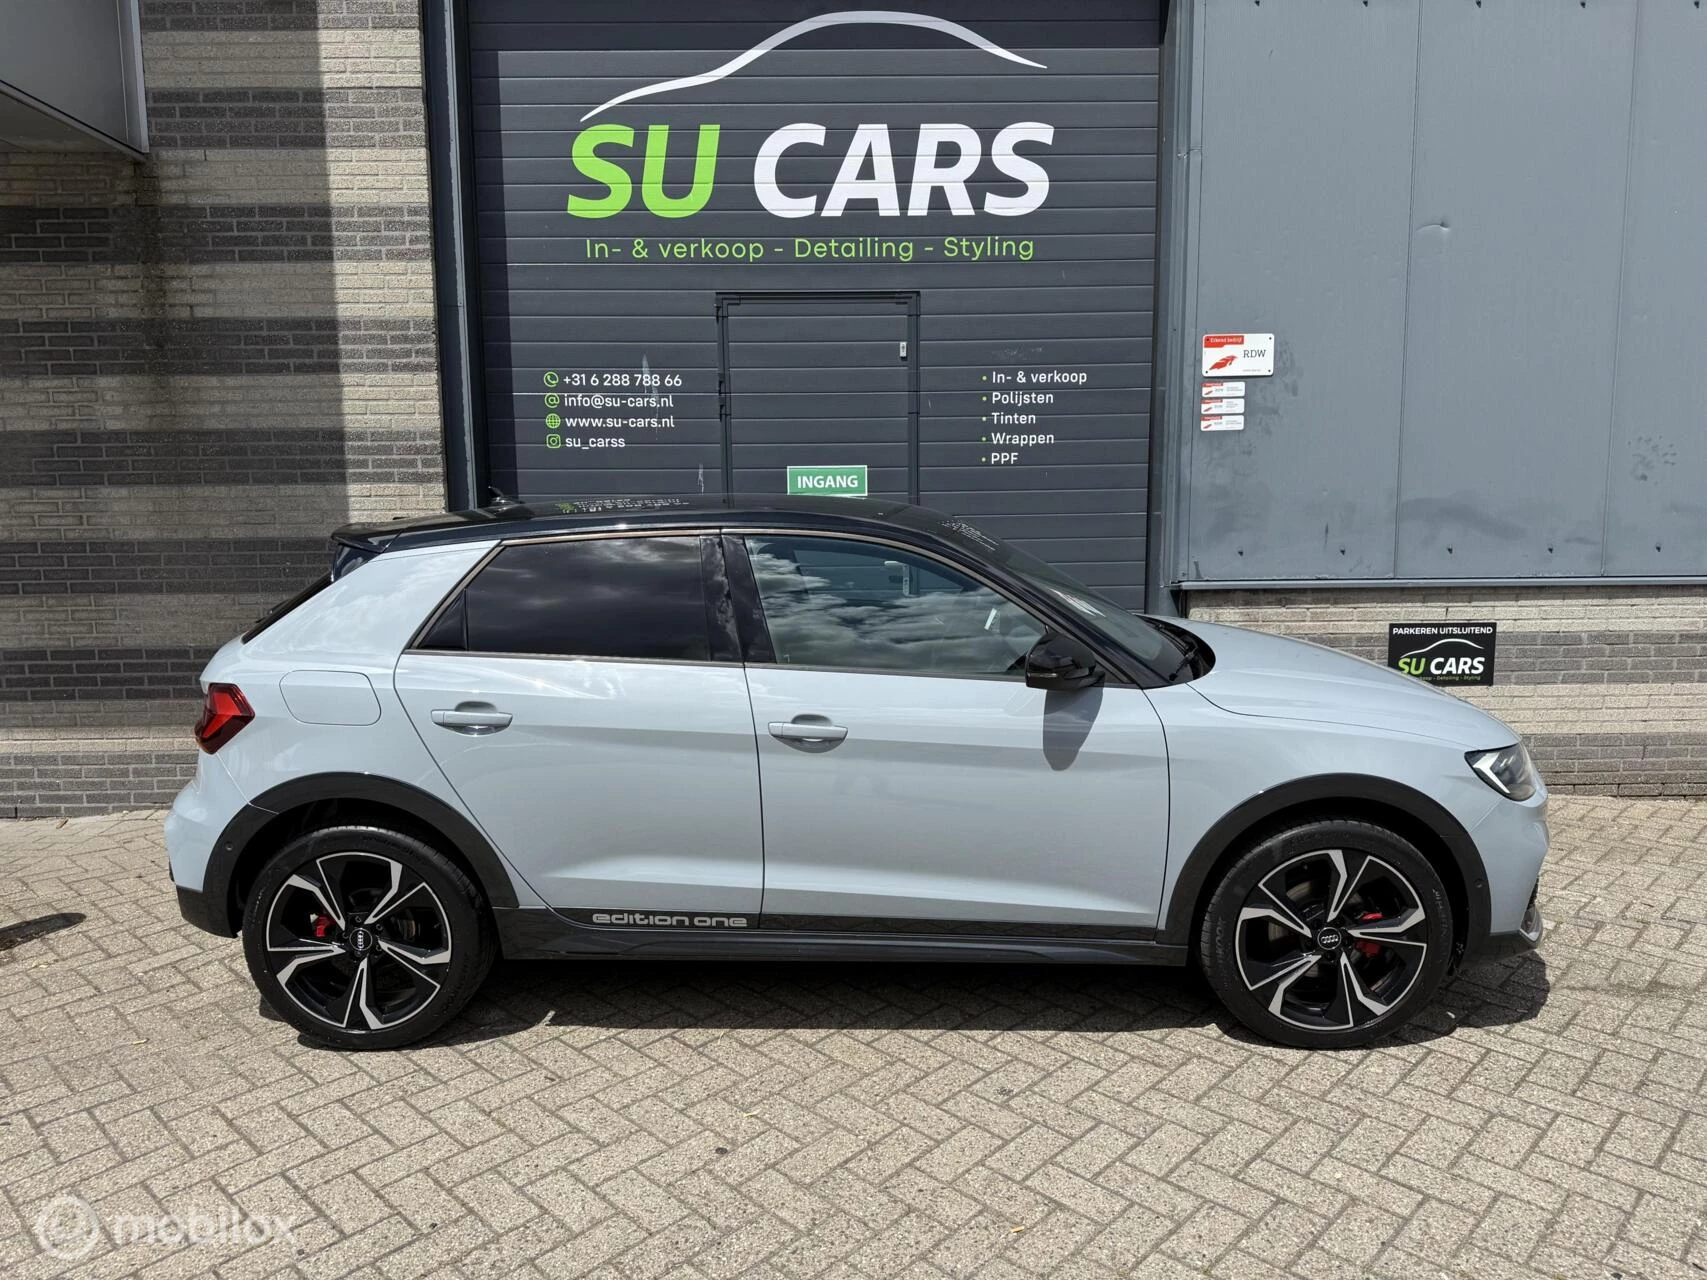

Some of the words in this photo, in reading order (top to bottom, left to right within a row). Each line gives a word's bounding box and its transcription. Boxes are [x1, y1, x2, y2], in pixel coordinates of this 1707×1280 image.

[567, 124, 720, 218] SU
[753, 121, 1055, 218] CARS
[585, 239, 622, 259] In-
[631, 239, 649, 259] &
[658, 238, 764, 264] verkoop
[794, 237, 914, 261] Detailing
[943, 236, 1035, 261] Styling
[1243, 349, 1267, 358] RDW
[563, 373, 586, 387] +31
[590, 374, 600, 387] 6
[603, 374, 631, 387] 288
[634, 374, 661, 387] 788
[664, 374, 683, 387] 66
[992, 371, 1012, 383] In-
[1016, 370, 1027, 383] &
[1030, 370, 1088, 385] verkoop
[564, 394, 674, 408] info@su-cars.nl
[992, 392, 1054, 406] Polijsten
[565, 416, 675, 428] www.su-cars.nl
[991, 412, 1036, 424] Tinten
[565, 438, 626, 450] su_carss
[991, 432, 1055, 447] Wrappen
[991, 453, 1019, 464] PPF
[797, 475, 858, 489] INGANG
[1398, 658, 1426, 675] SU
[1430, 657, 1486, 675] CARS
[592, 913, 690, 926] edition
[694, 916, 748, 926] one
